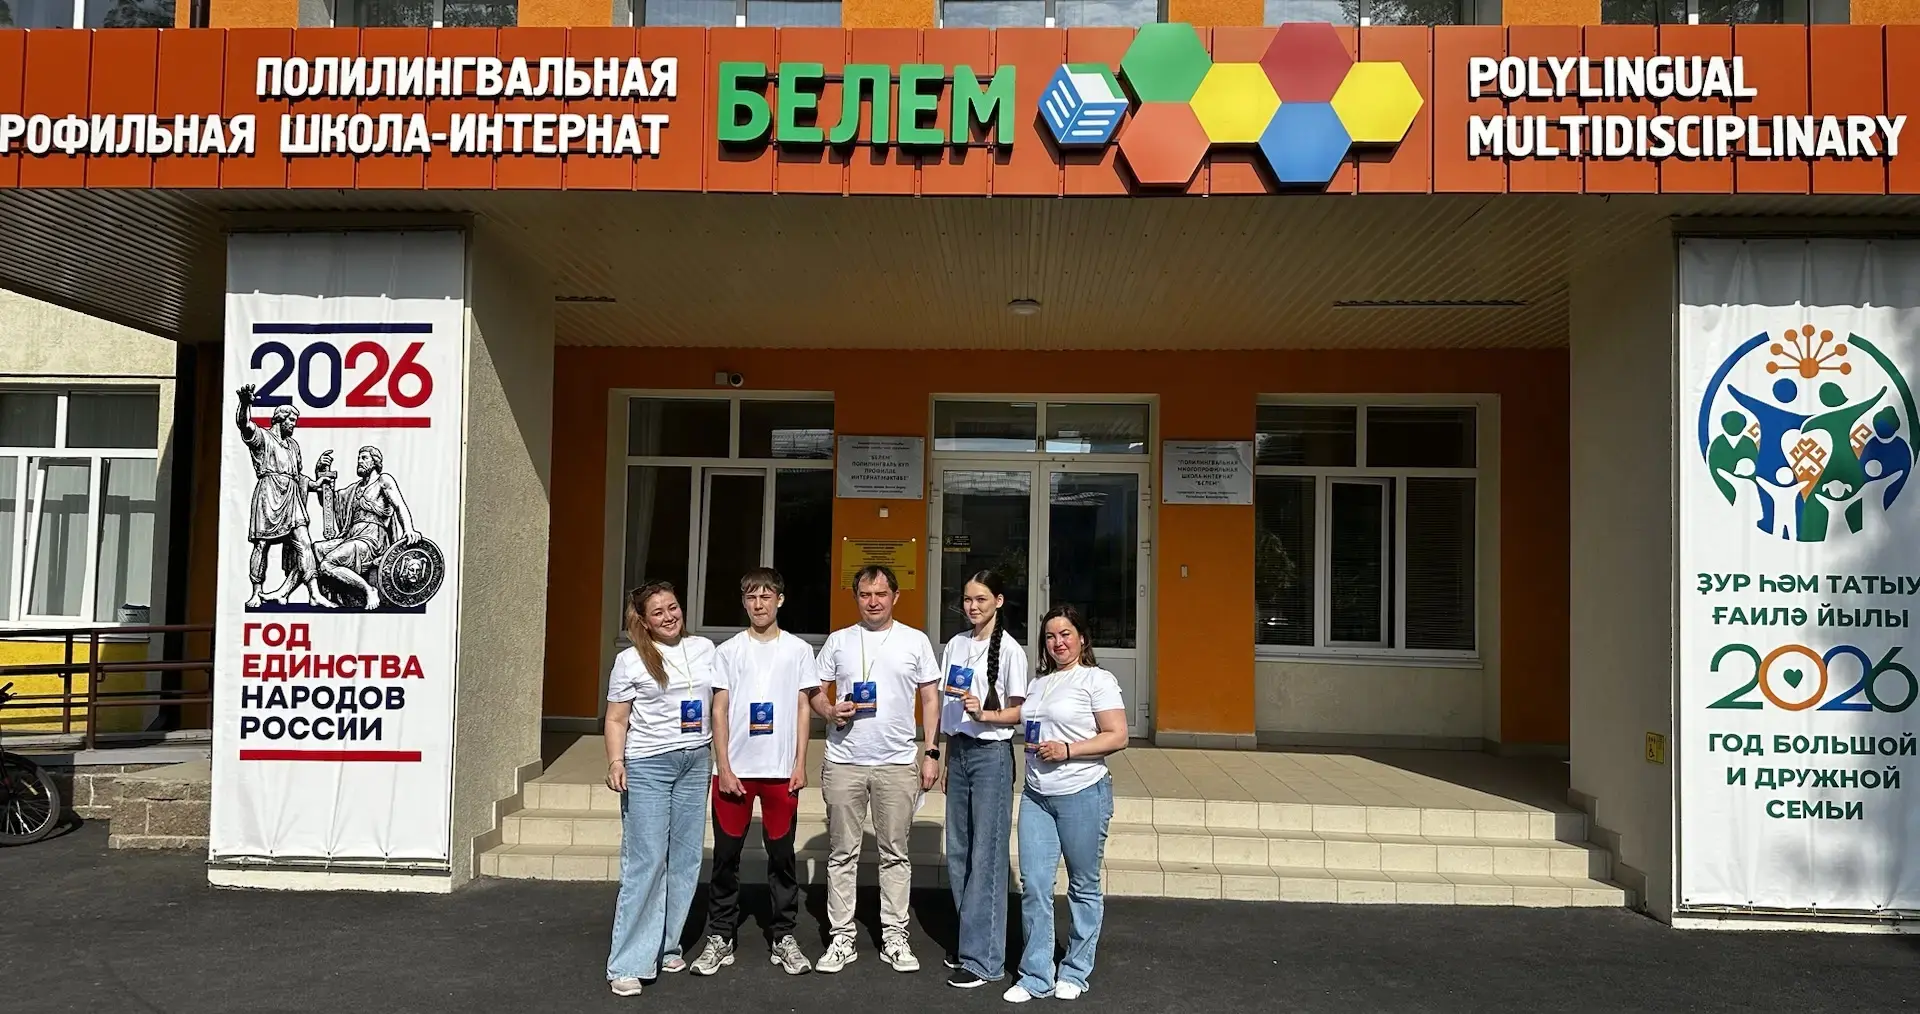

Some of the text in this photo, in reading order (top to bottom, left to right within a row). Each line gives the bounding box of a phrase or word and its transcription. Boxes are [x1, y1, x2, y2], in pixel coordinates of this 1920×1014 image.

[256, 56, 678, 98] ПОЛИЛИНГВАЛЬНАЯ
[1469, 55, 1758, 98] POLYLINGUAL
[718, 62, 1016, 145] БЕЛЕМ
[280, 113, 669, 154] ШКОЛА-ИНТЕРНАТ
[1468, 114, 1907, 157] MULTIDISCIPLINARY
[250, 340, 434, 409] 2026
[1826, 575, 1920, 596] ТАТЫУ
[1817, 602, 1909, 628] ЙЫЛЫ
[243, 623, 311, 651] ГОД
[242, 654, 425, 682] ЕДИНСТВА
[1705, 643, 1919, 713] 2026
[241, 686, 405, 714] НАРОДОВ
[240, 716, 382, 741] РОССИИ
[1709, 732, 1917, 756] ГОД БОЛЬШОЙ
[1727, 765, 1901, 790] И ДРУЖНОЙ
[1766, 799, 1864, 821] СЕМЬИ
